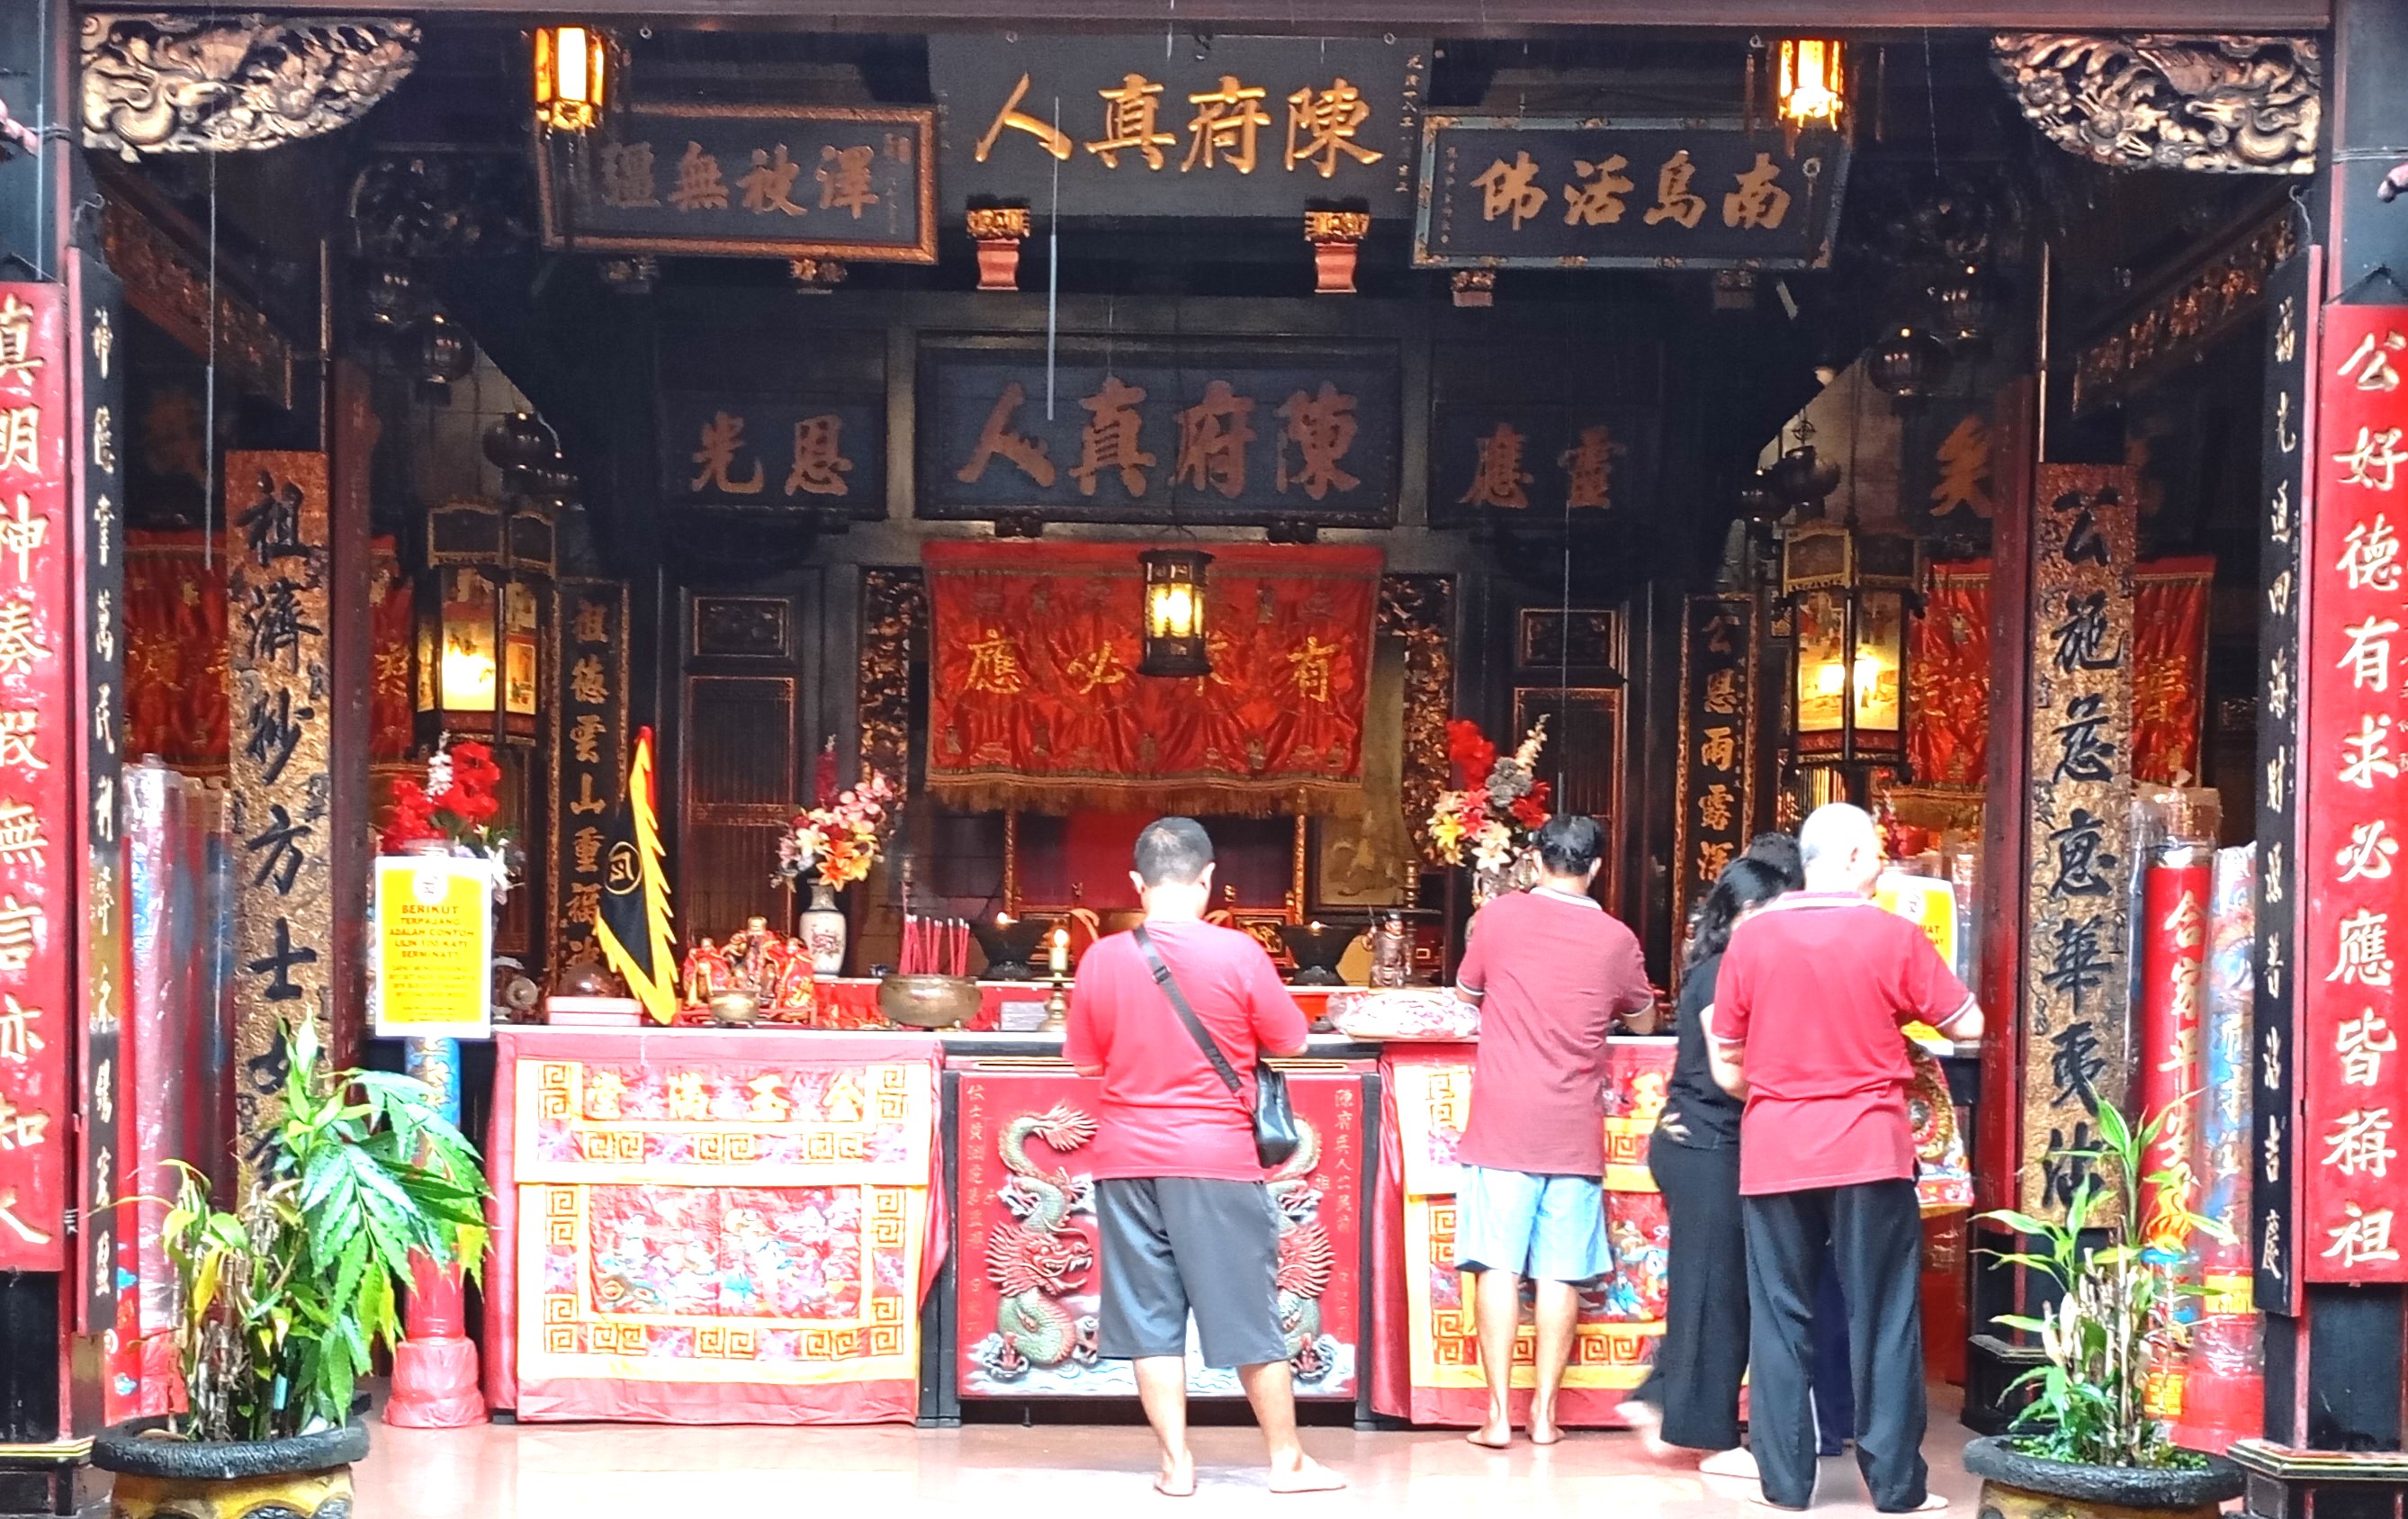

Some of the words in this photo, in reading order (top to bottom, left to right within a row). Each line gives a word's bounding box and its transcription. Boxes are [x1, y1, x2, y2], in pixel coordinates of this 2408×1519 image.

[975, 73, 1384, 178] 陳府真人
[691, 410, 854, 497] 恩光
[957, 375, 1361, 500] 陳府真人
[963, 627, 1341, 704] 有必應
[2320, 332, 2408, 1267] 公好德有求必應皆稱祖
[401, 904, 459, 914] BERIKUT
[584, 1071, 865, 1122] 金玉滿堂
